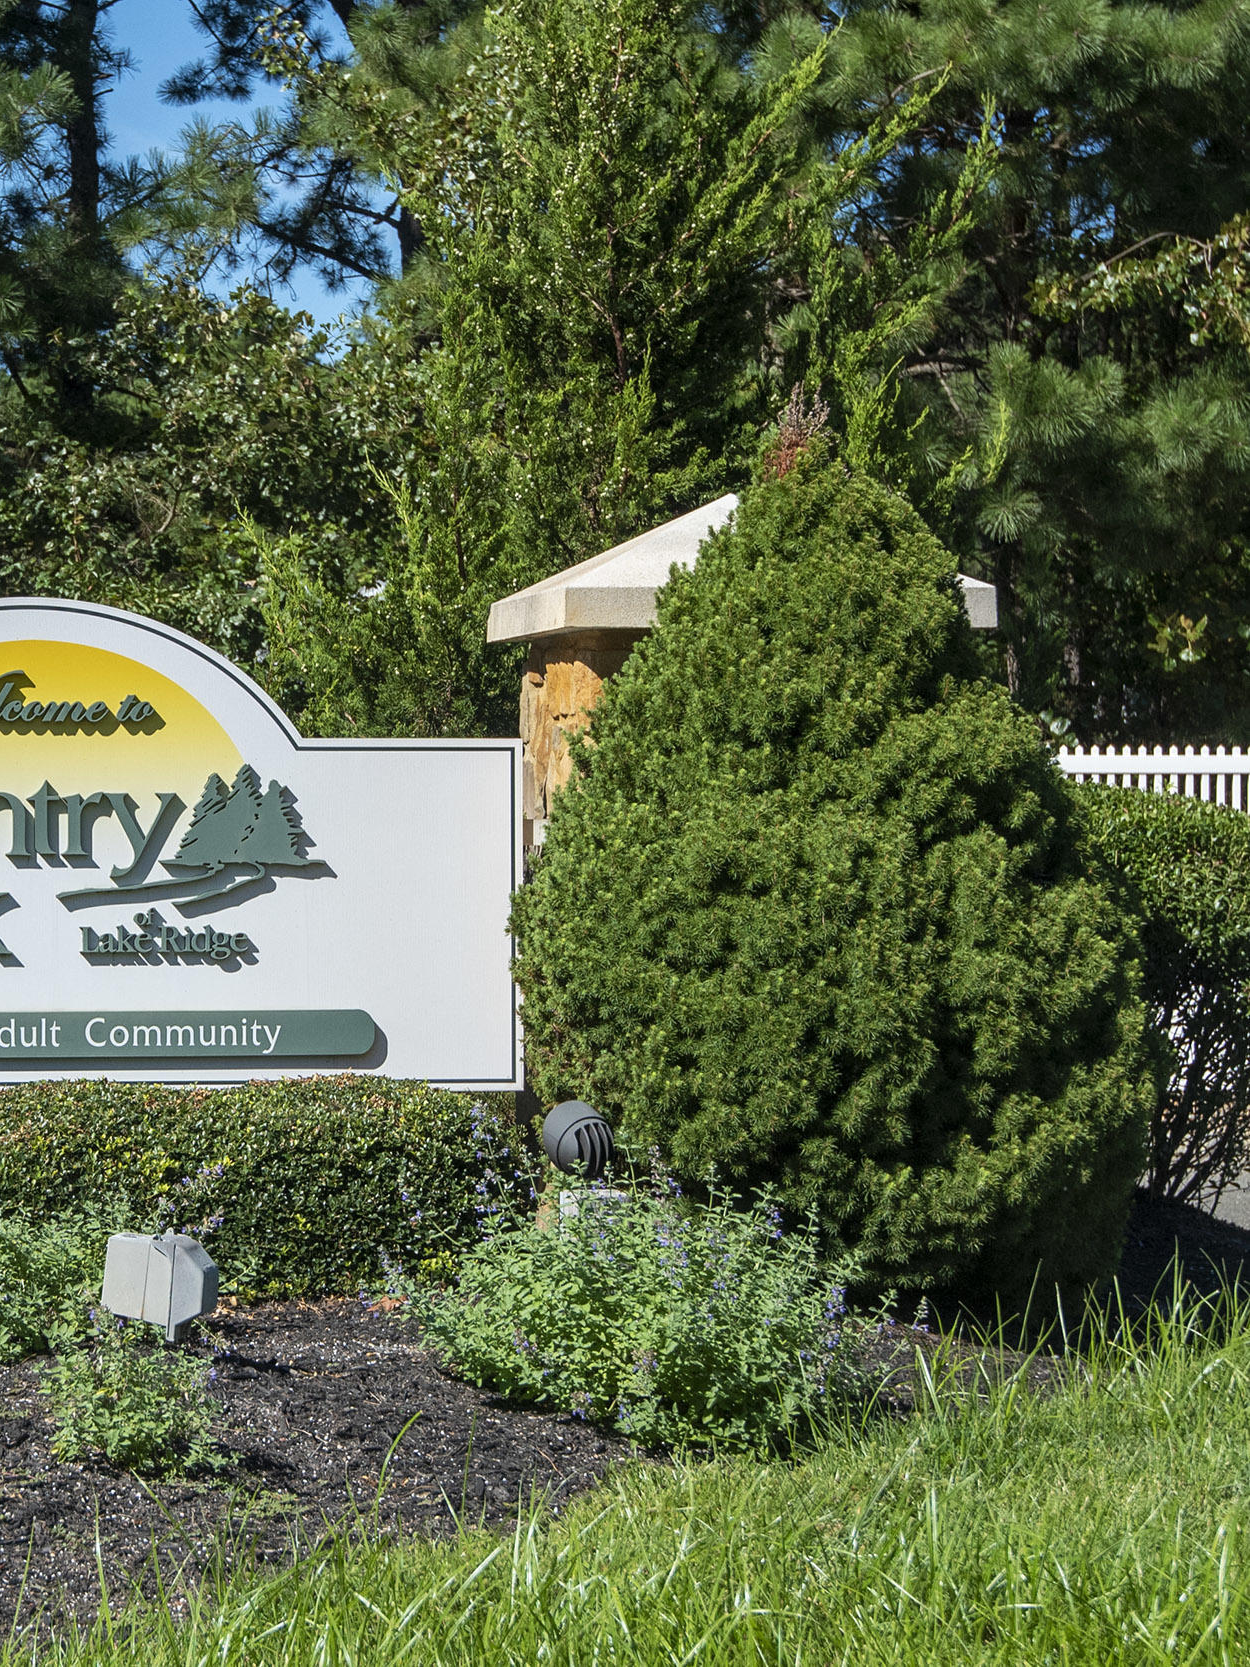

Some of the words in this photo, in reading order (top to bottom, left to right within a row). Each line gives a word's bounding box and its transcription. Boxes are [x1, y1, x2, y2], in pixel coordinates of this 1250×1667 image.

[116, 694, 154, 721] to
[133, 908, 155, 926] of
[80, 927, 154, 954] Lake
[160, 926, 249, 959] Ridge
[84, 1017, 282, 1054] Community
